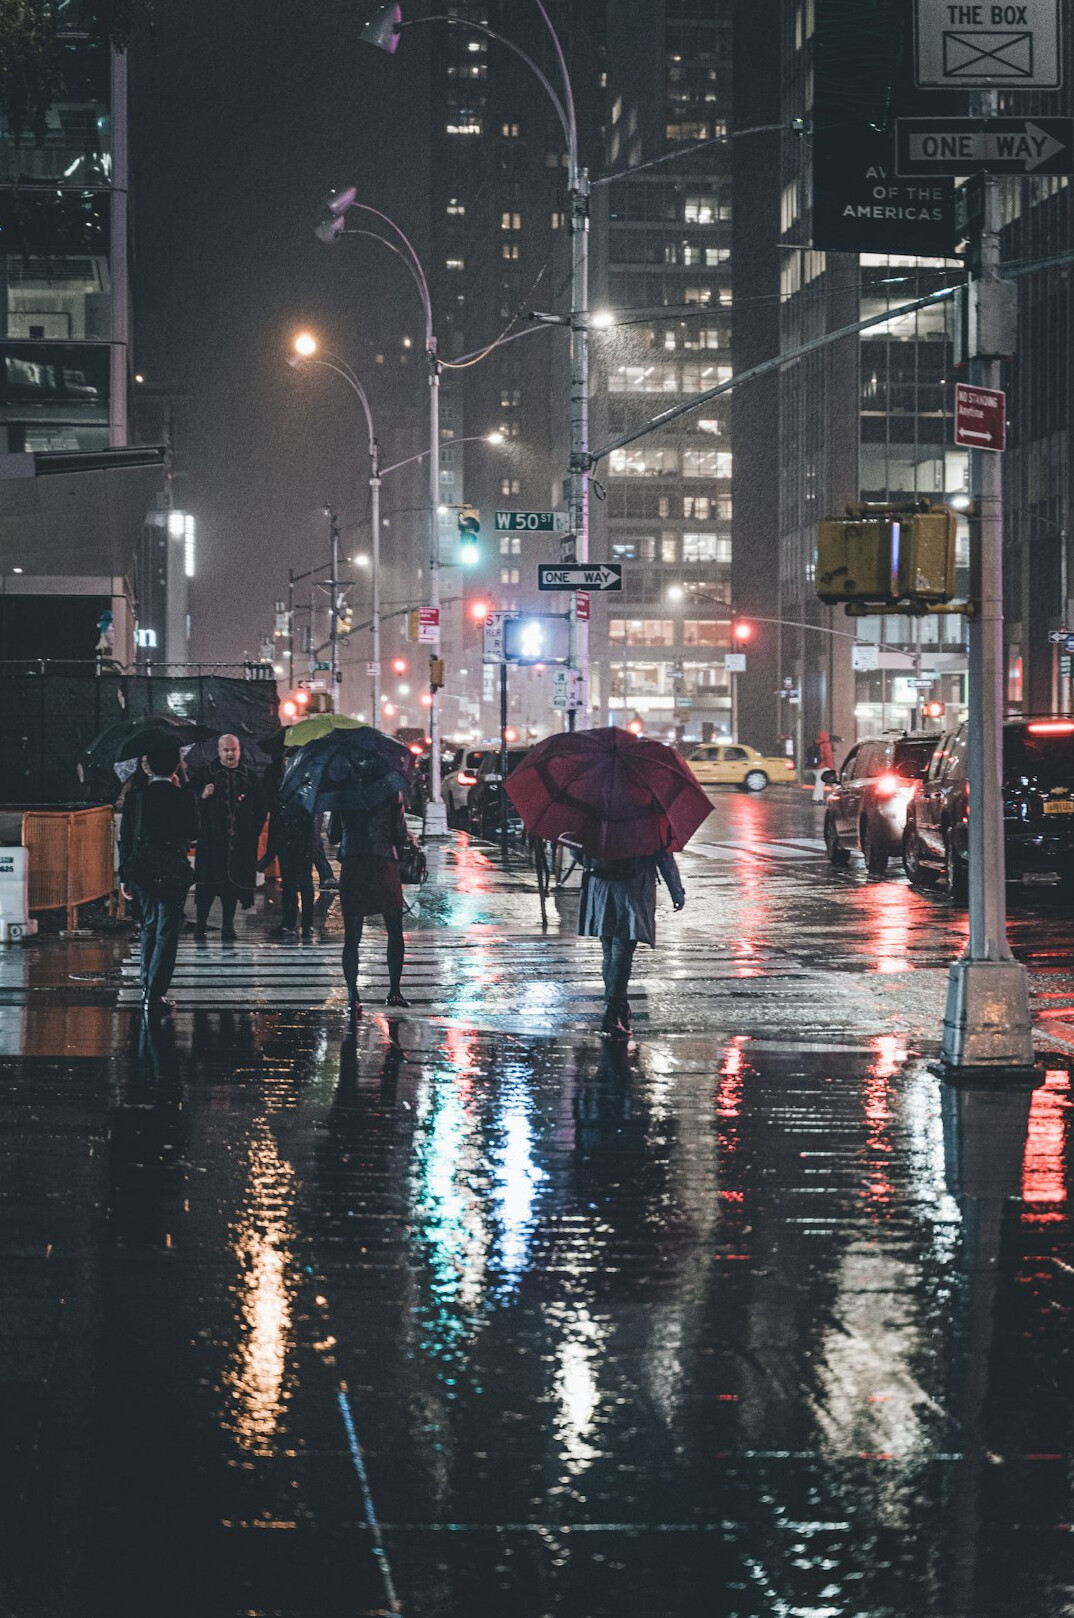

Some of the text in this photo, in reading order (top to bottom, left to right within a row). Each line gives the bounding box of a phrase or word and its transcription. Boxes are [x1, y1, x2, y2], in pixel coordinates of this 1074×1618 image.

[947, 5, 1028, 25] THE BOX
[922, 136, 1047, 158] ONE WAY
[872, 186, 943, 200] OF THE
[841, 204, 943, 221] AMERICAS
[497, 513, 553, 530] W 50 ST
[545, 571, 612, 583] ONE WAY
